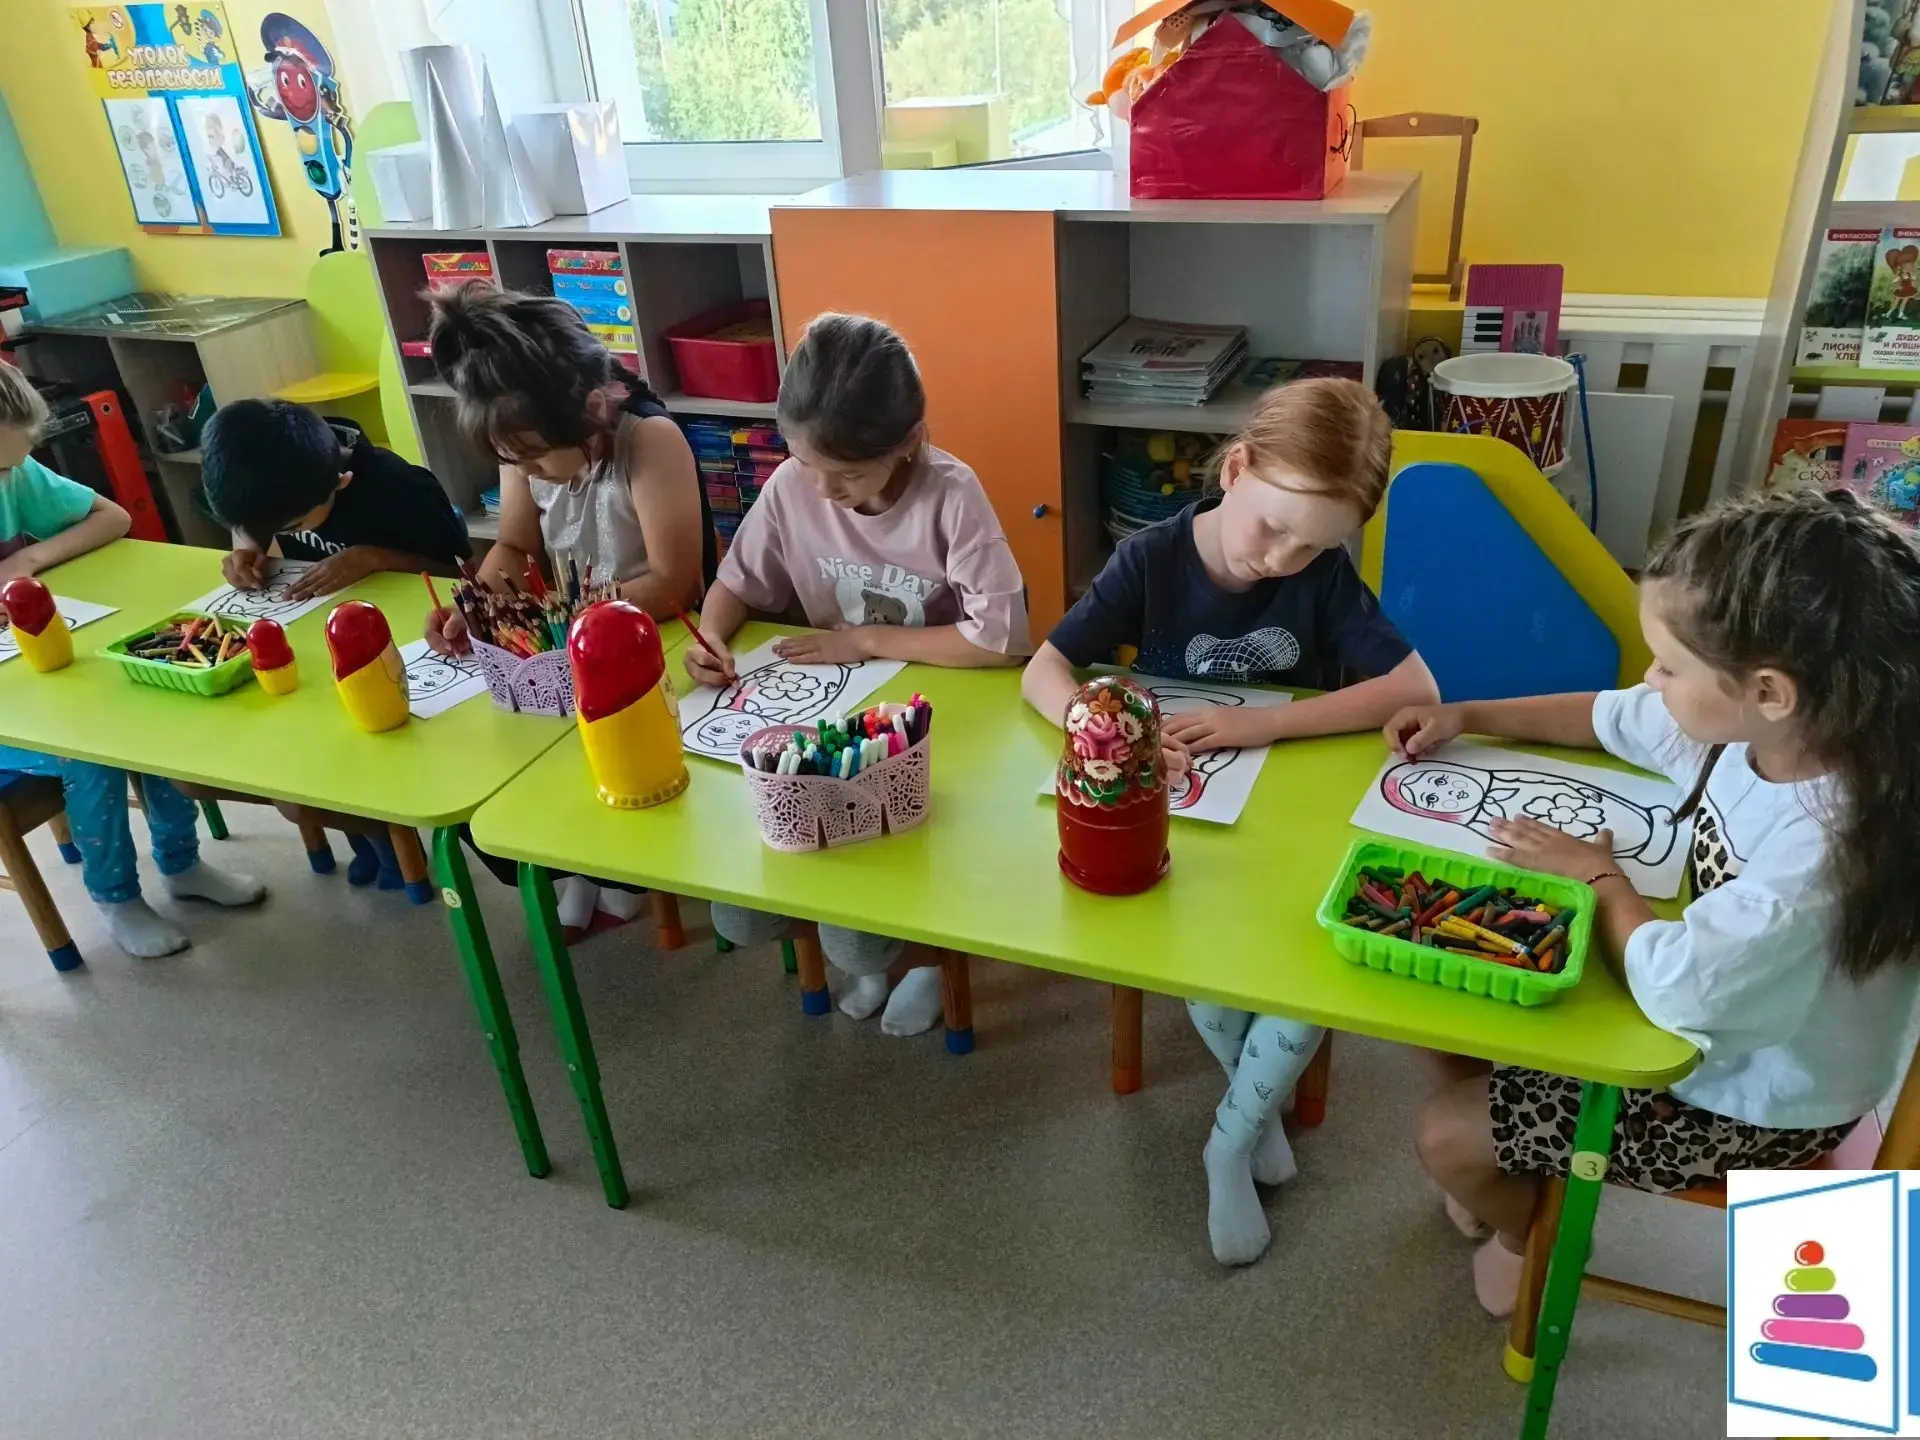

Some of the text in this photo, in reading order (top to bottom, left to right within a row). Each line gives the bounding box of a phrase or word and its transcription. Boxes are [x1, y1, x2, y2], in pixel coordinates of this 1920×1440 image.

[127, 45, 188, 68] УГОЛОК
[817, 557, 941, 602] Nice Day
[1583, 1160, 1598, 1177] 3
